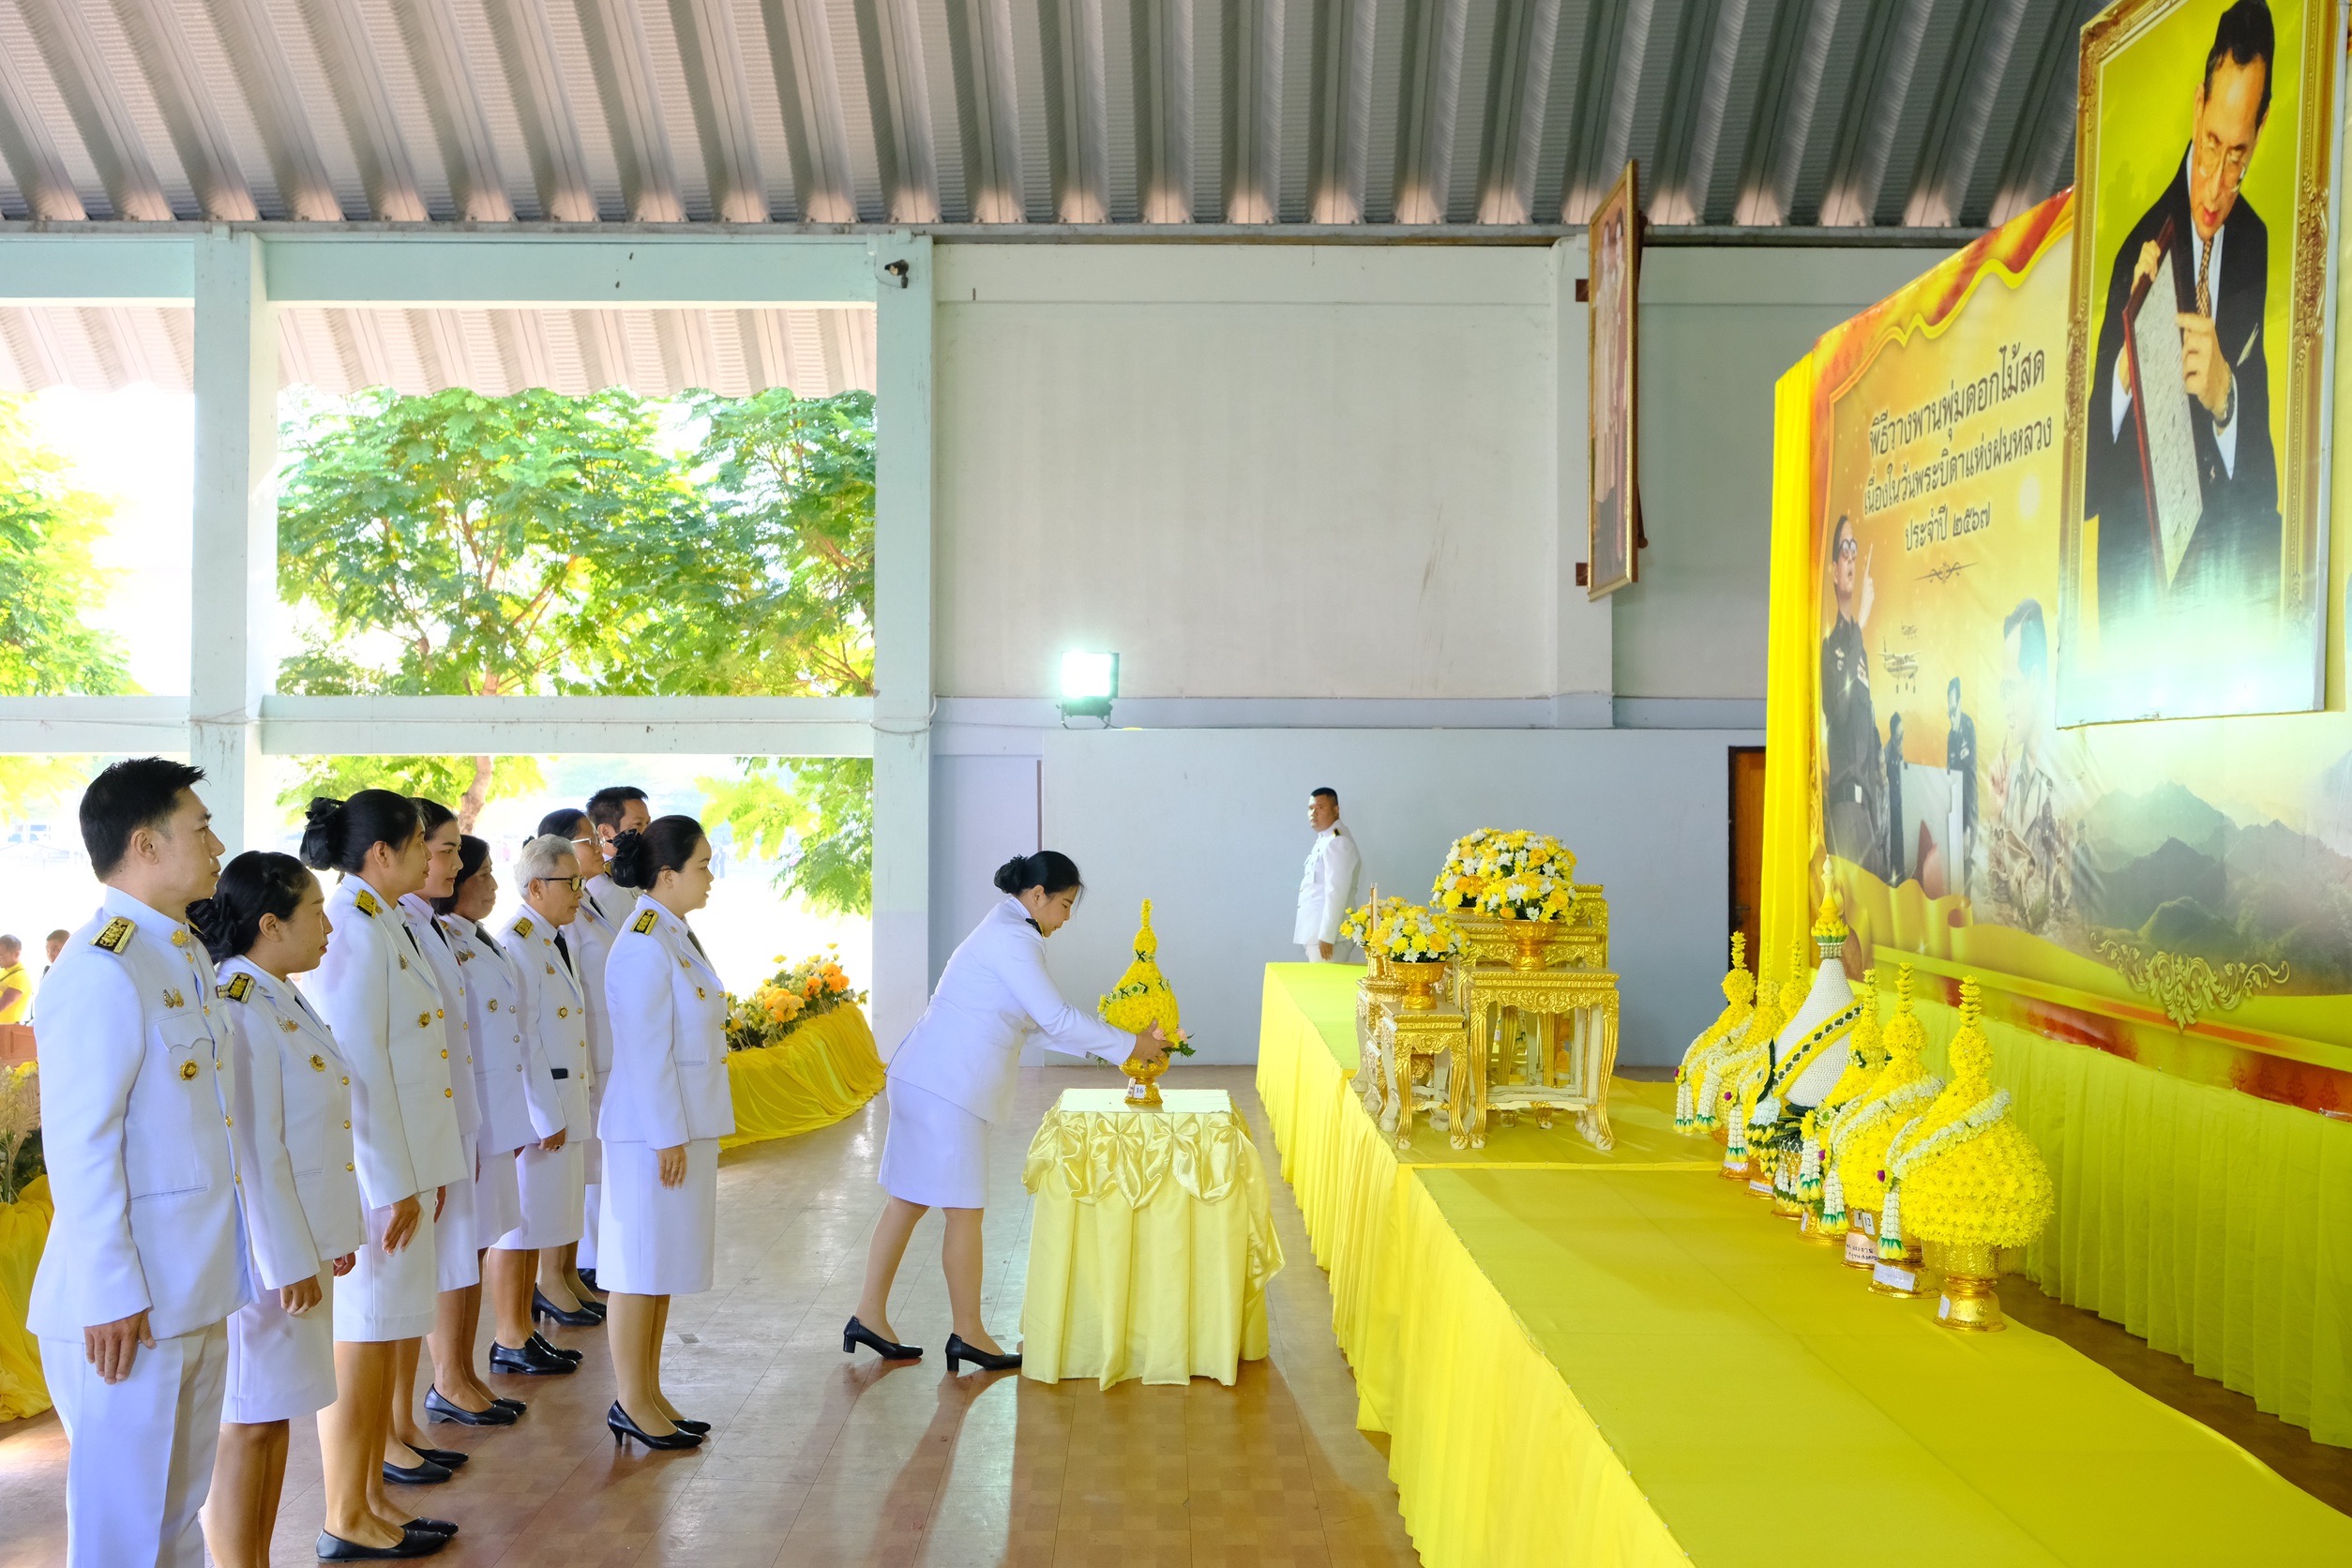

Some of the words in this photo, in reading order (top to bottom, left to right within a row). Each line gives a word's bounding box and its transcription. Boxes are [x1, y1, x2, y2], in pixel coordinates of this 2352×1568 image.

[1869, 341, 2045, 458] พิธีวางพานพุ่มดอกไม้สด
[1864, 416, 2053, 515] เนื่องในวันพระบิดาแห่งฝนหลวง
[1905, 503, 1949, 551] ประจำปี
[1952, 501, 1991, 538] ๒๕๖๗
[1864, 1216, 1872, 1227] 12
